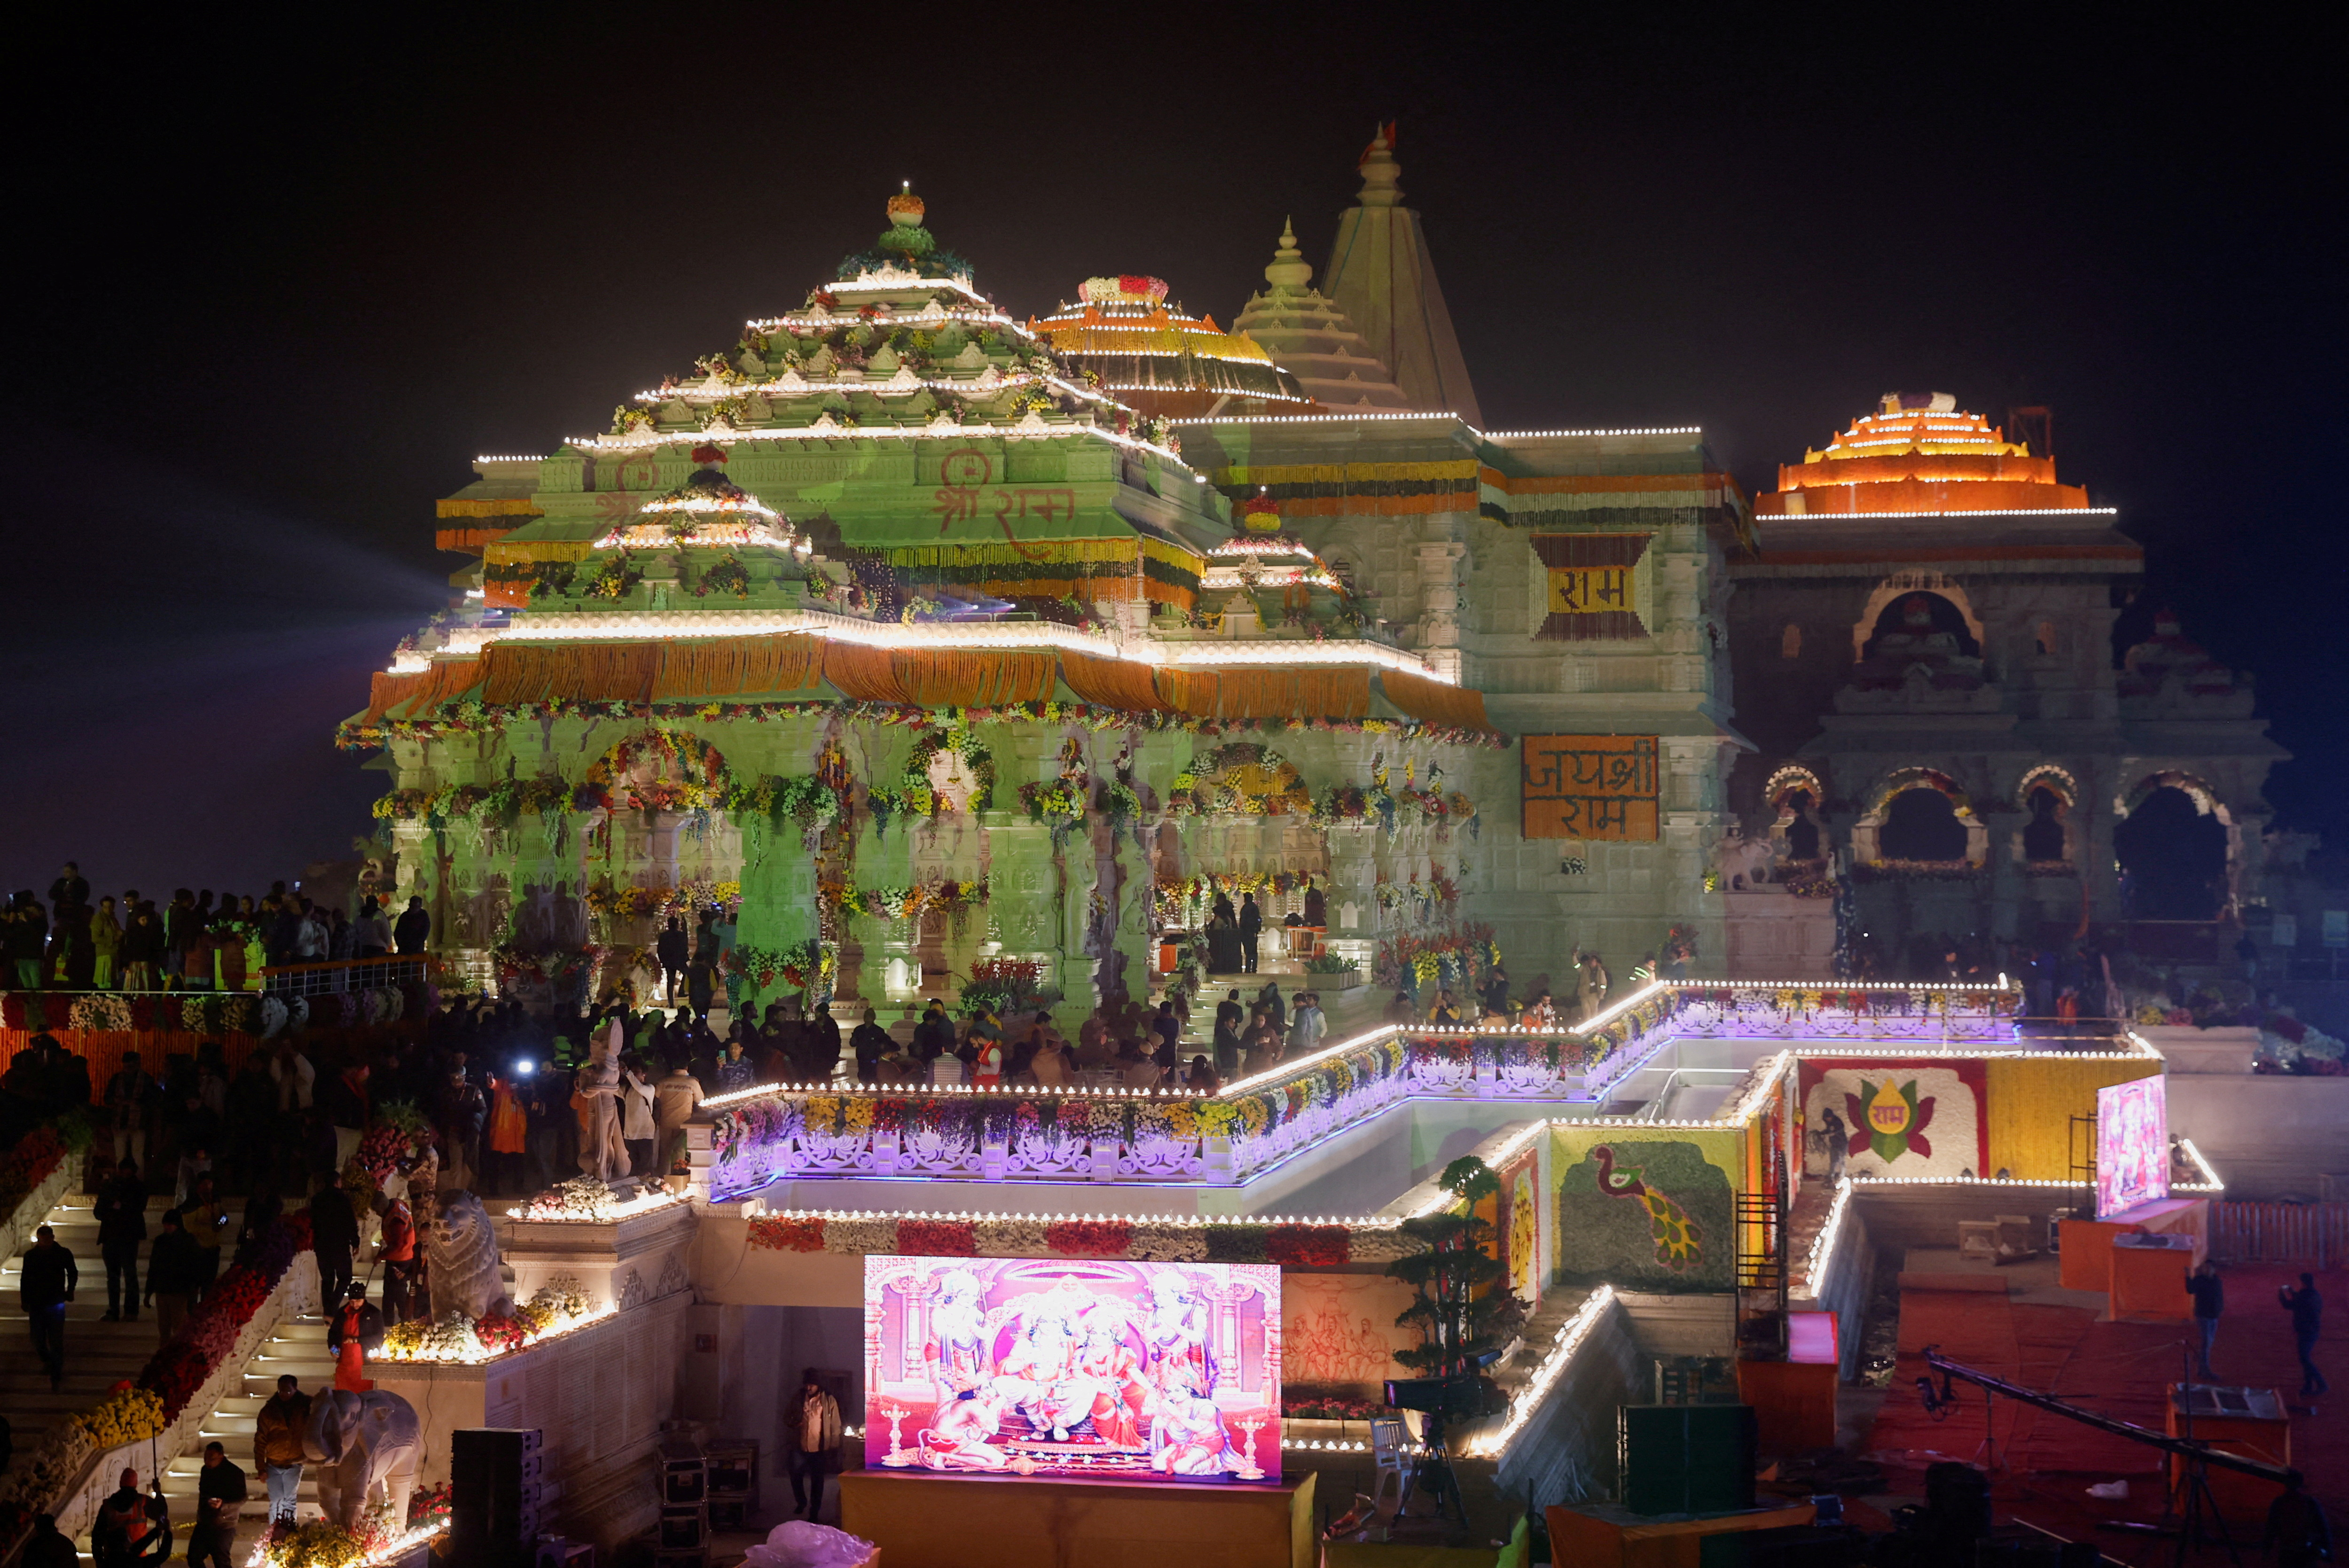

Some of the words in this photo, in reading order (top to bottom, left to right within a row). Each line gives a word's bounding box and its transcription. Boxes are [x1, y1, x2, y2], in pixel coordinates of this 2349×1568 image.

[929, 448, 992, 533] श्री
[994, 489, 1074, 560] राम
[1559, 569, 1625, 609] राम
[1561, 795, 1626, 836] राम
[1873, 1106, 1905, 1125] राम
